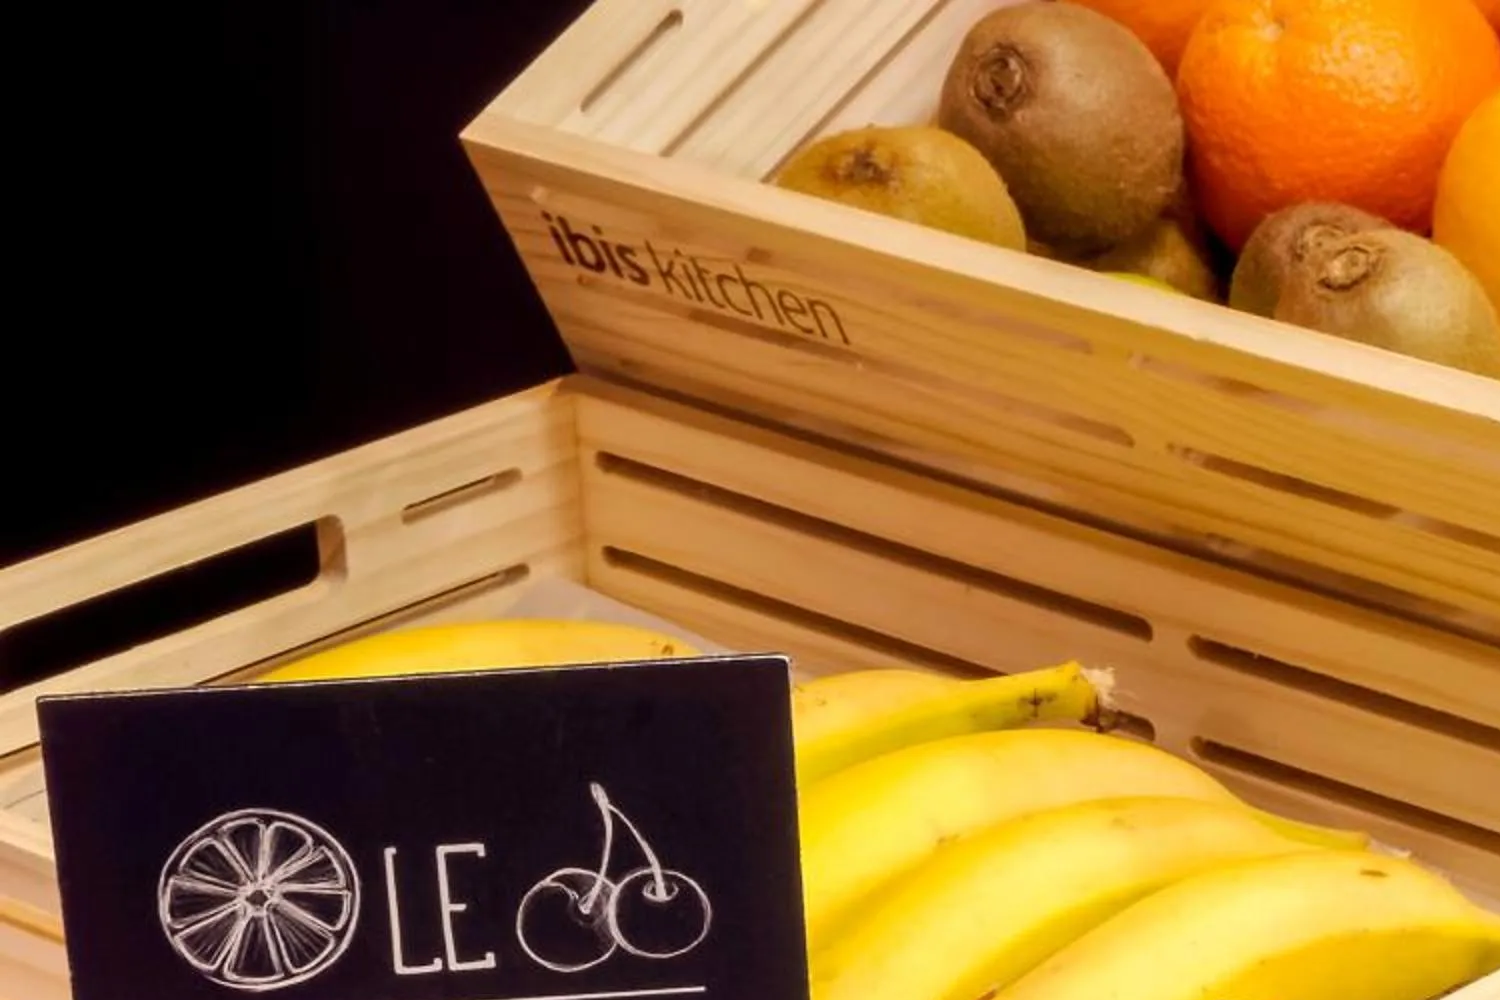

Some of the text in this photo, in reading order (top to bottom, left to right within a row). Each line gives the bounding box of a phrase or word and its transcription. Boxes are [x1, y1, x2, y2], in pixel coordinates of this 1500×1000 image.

[541, 210, 850, 345] ibis kitchen
[384, 843, 496, 975] LE
